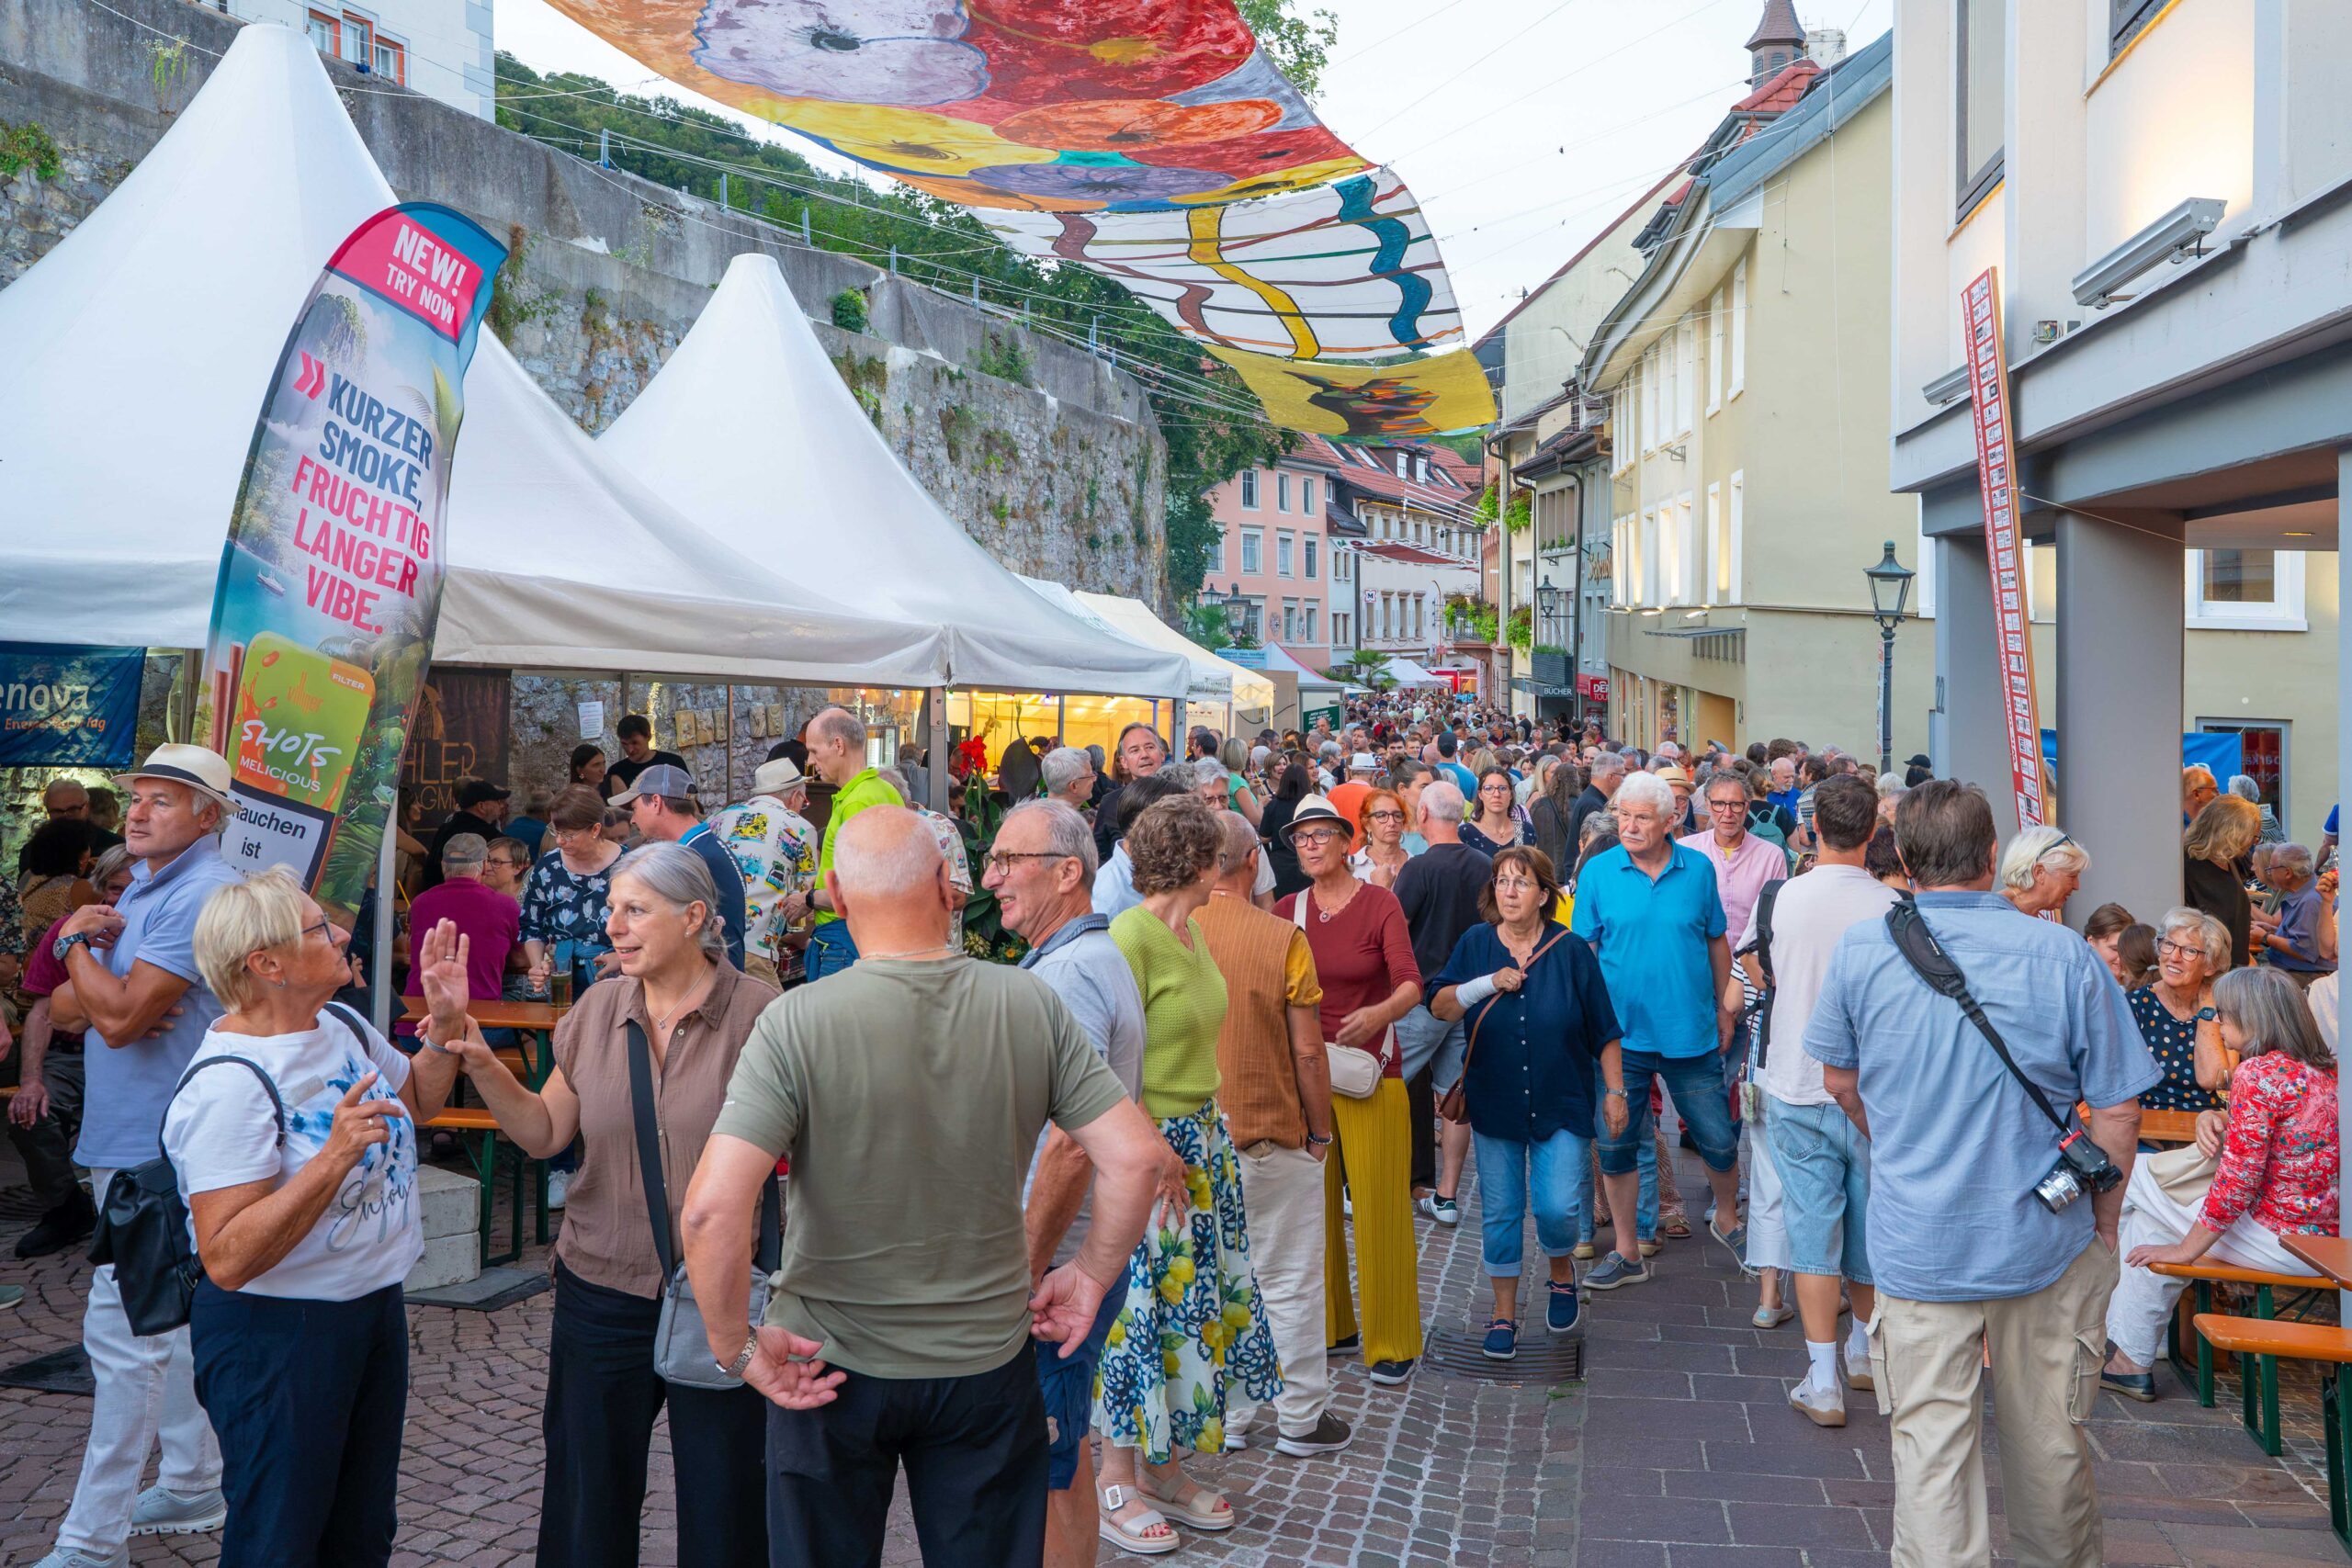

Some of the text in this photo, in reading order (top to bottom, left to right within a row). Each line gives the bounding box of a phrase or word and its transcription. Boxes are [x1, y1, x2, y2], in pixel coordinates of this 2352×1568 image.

[392, 223, 467, 297] NEW!
[386, 263, 456, 324] TRY NOW
[327, 373, 433, 471] KURZER
[319, 421, 423, 513] SMOKE,
[290, 455, 430, 559] FRUCHTIG
[293, 507, 419, 599] LANGER
[306, 563, 385, 635] VIBE.
[0, 682, 89, 711] nova
[332, 672, 366, 691] FILTER
[1544, 686, 1573, 695] BÜCHER
[240, 755, 321, 793] MELICIOUS
[242, 719, 342, 767] SHOTS
[241, 836, 262, 860] ist
[326, 1179, 413, 1252] Enjoy
